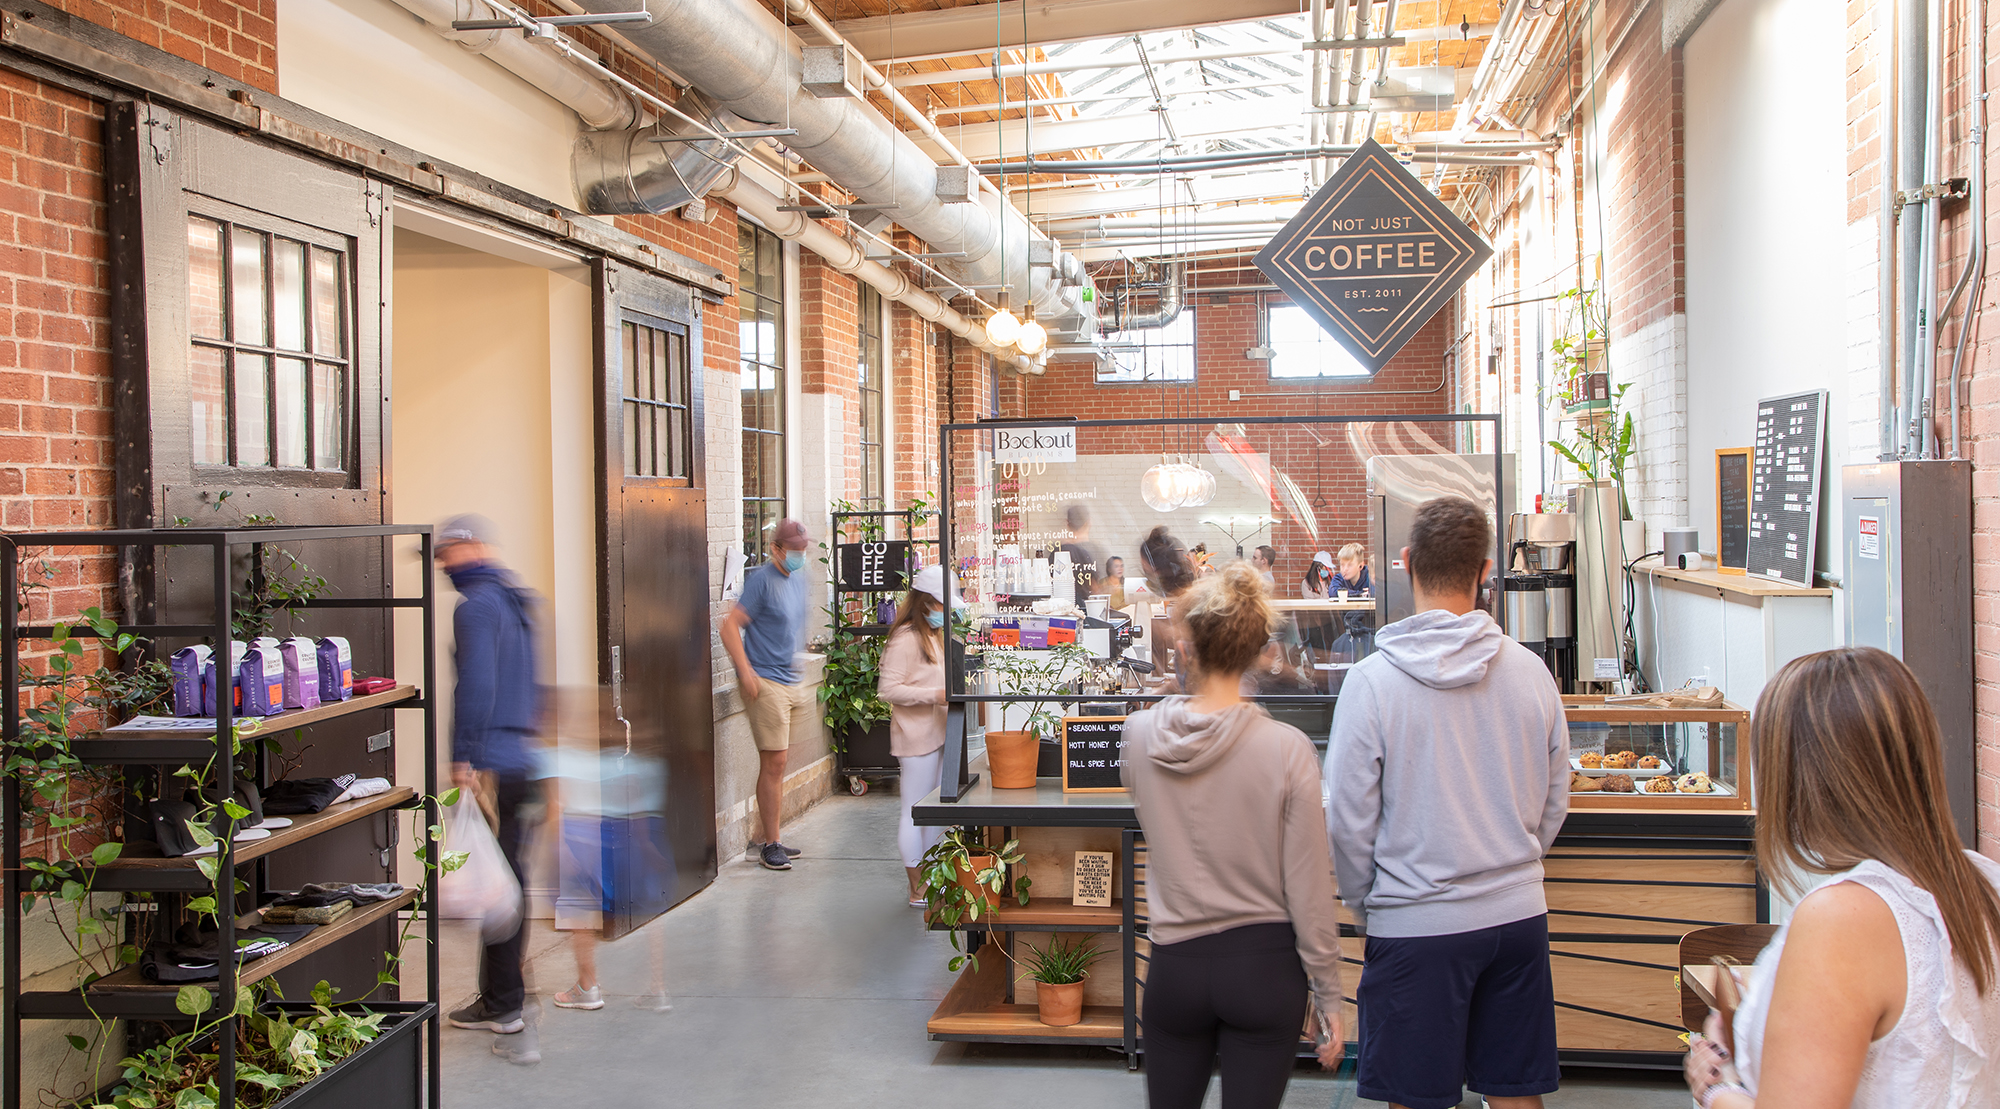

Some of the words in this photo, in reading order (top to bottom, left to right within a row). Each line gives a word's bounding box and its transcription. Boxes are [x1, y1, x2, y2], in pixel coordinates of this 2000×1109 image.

[1332, 218, 1364, 231] NOT
[1370, 216, 1412, 230] JUST
[1304, 241, 1436, 271] COFFEE
[1344, 290, 1371, 299] EST.
[1375, 288, 1402, 298] 2011
[1008, 451, 1063, 459] BLOOMS
[984, 455, 1046, 479] FOOD
[955, 481, 991, 500] yogurt
[995, 479, 1031, 494] parfait
[1003, 502, 1043, 514] compote
[1045, 502, 1058, 513] $8
[959, 521, 988, 534] Liege
[993, 518, 1025, 530] waffle
[861, 542, 888, 556] CO
[1046, 540, 1062, 553] $9
[861, 556, 884, 571] FF
[960, 554, 997, 567] Avocado
[998, 553, 1024, 565] Toast
[1083, 560, 1097, 572] red
[861, 571, 884, 586] EE
[1077, 572, 1092, 586] $9
[962, 592, 980, 603] Lox
[985, 591, 1012, 603] Toast
[999, 604, 1021, 614] caper
[999, 615, 1013, 625] dill
[965, 631, 1008, 643] Add-Ons
[968, 643, 1000, 653] poached
[1073, 724, 1106, 732] SEASONAL
[1109, 724, 1127, 732] MENU
[1068, 741, 1086, 749] HOTT
[1088, 741, 1110, 749] HONEY
[1069, 760, 1086, 769] FALL
[1088, 760, 1105, 768] SPICE
